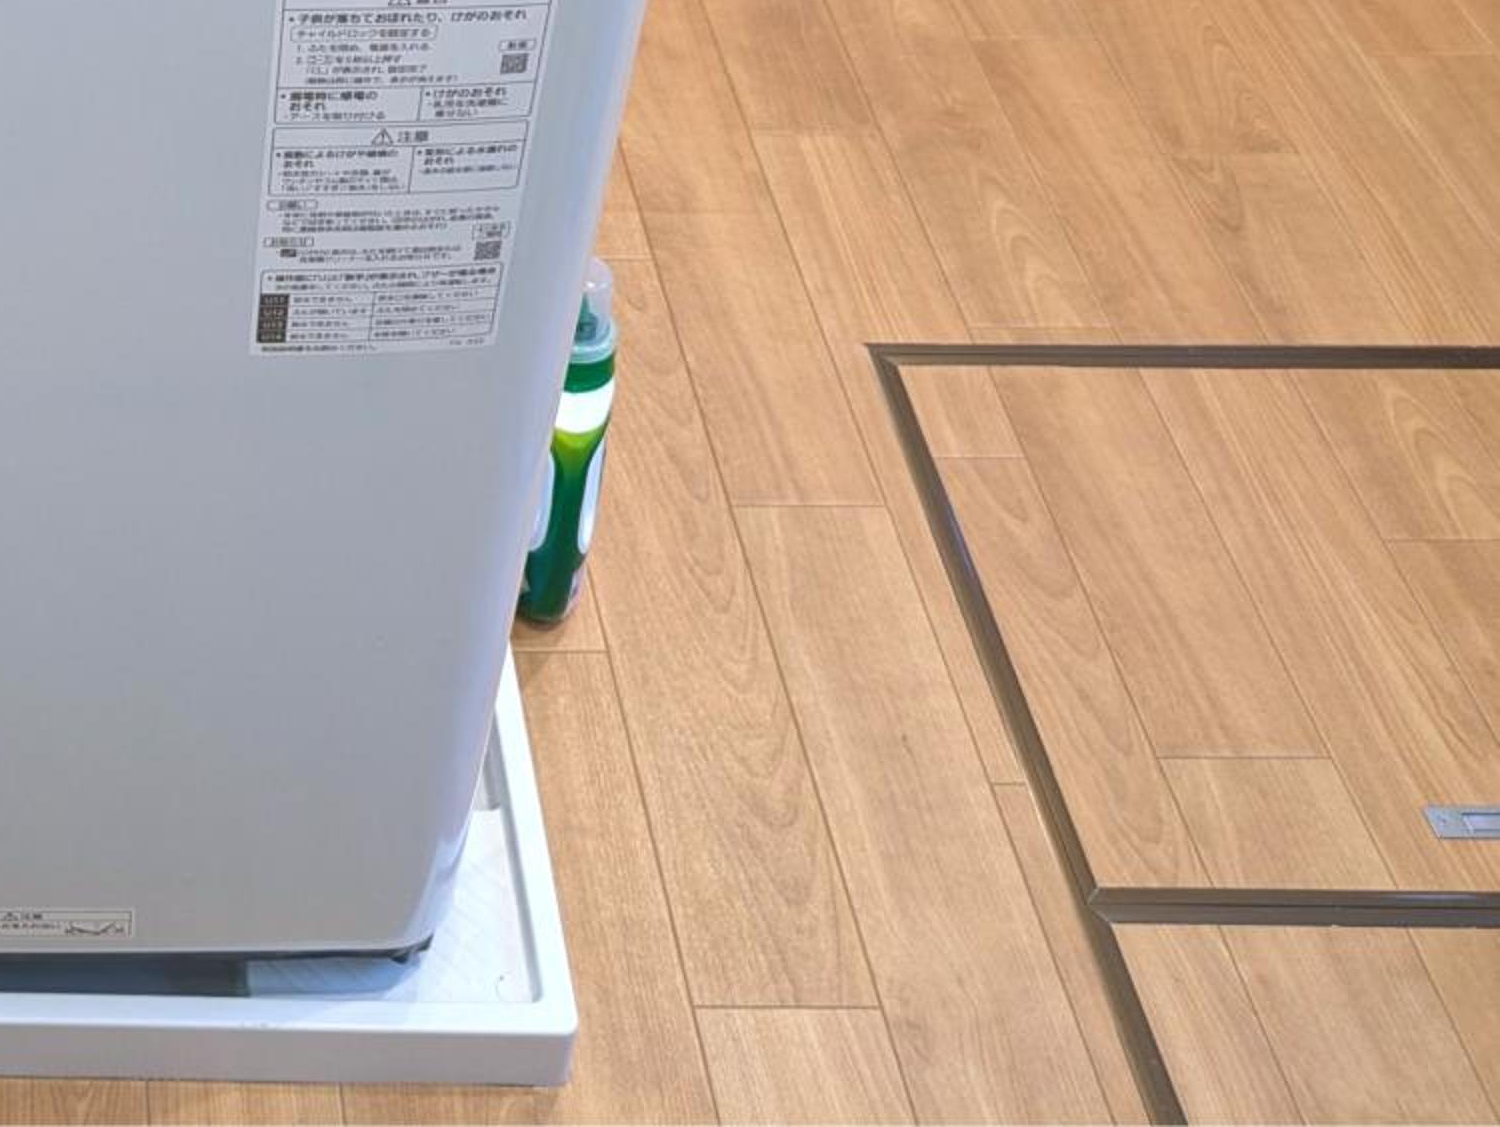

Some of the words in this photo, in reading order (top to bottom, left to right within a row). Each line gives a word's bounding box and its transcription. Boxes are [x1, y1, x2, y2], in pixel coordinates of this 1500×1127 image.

[289, 102, 326, 112] おそれ
[397, 130, 429, 142] 注意
